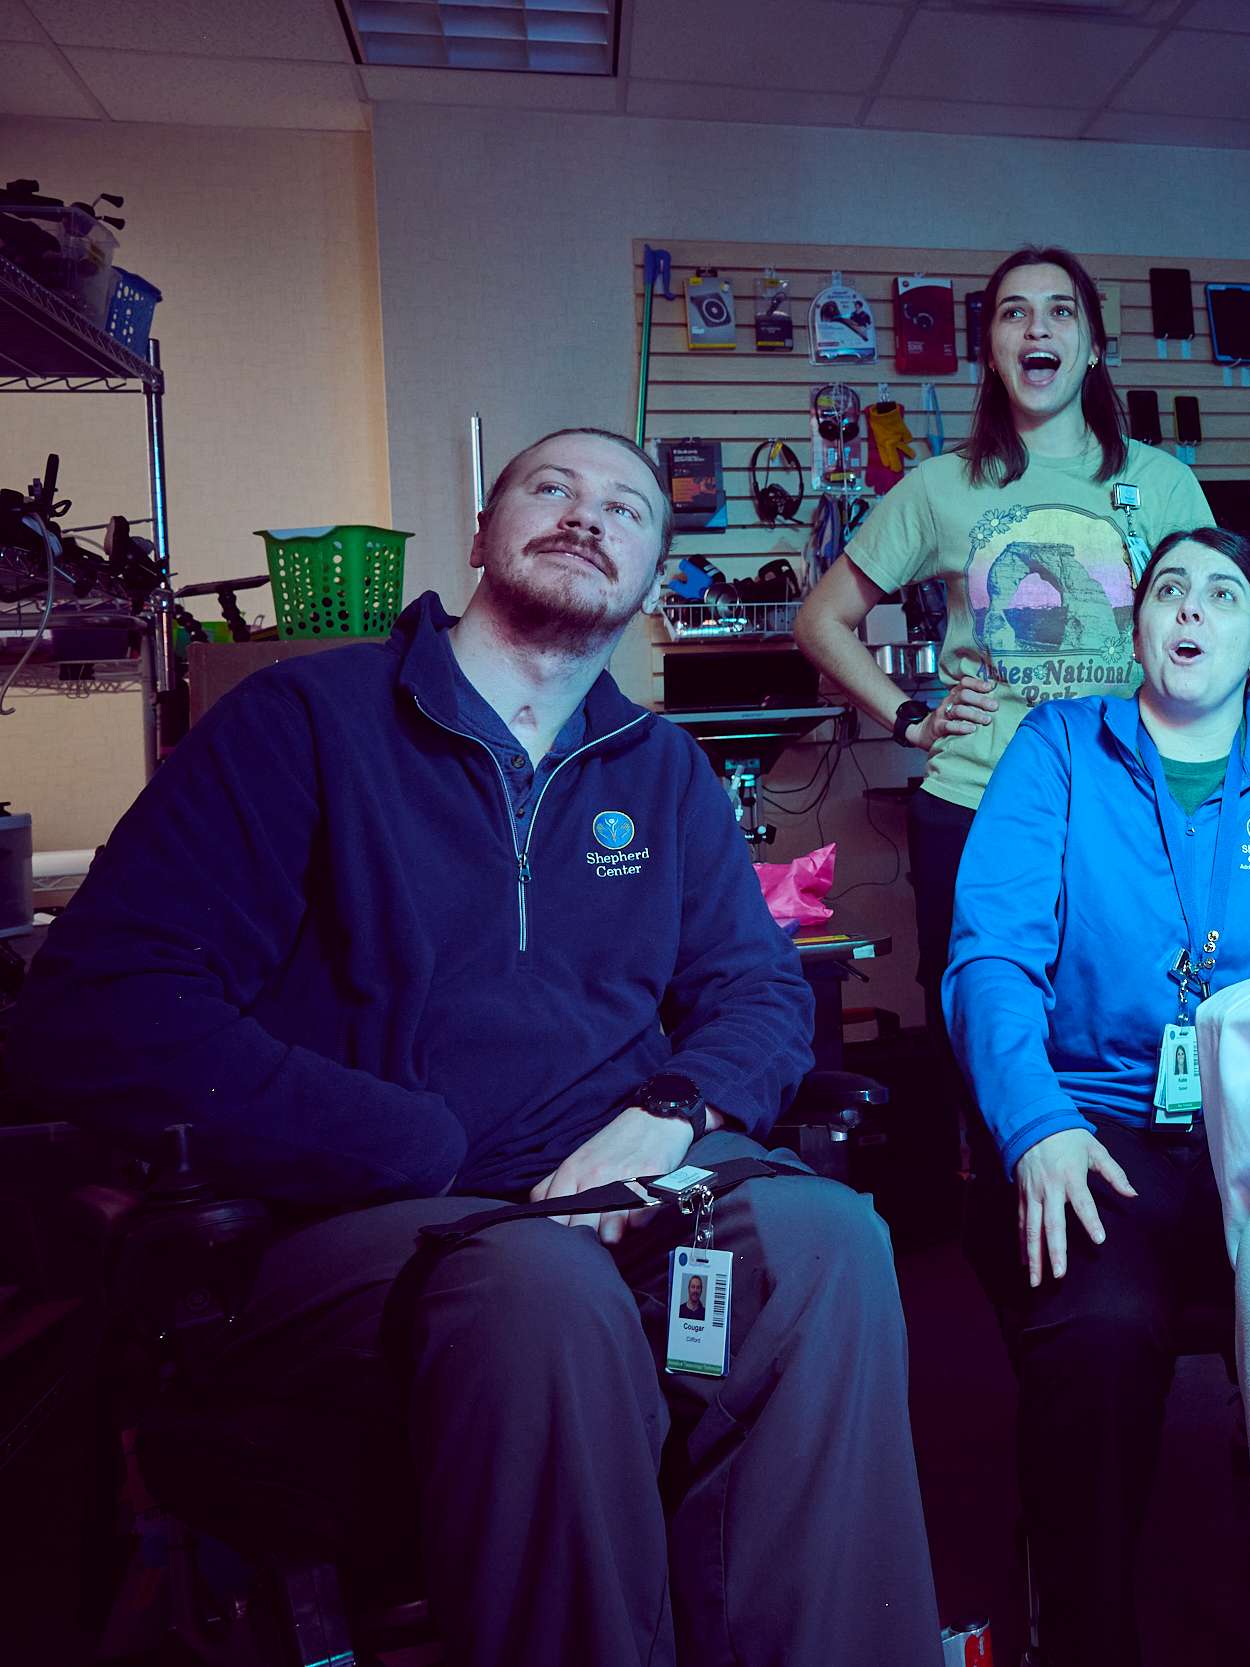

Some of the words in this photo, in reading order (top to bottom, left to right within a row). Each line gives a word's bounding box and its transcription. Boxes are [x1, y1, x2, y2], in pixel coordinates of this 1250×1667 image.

[1043, 659, 1133, 685] National
[586, 848, 650, 865] Shepherd
[596, 865, 642, 878] Center
[683, 1322, 705, 1332] Cougar
